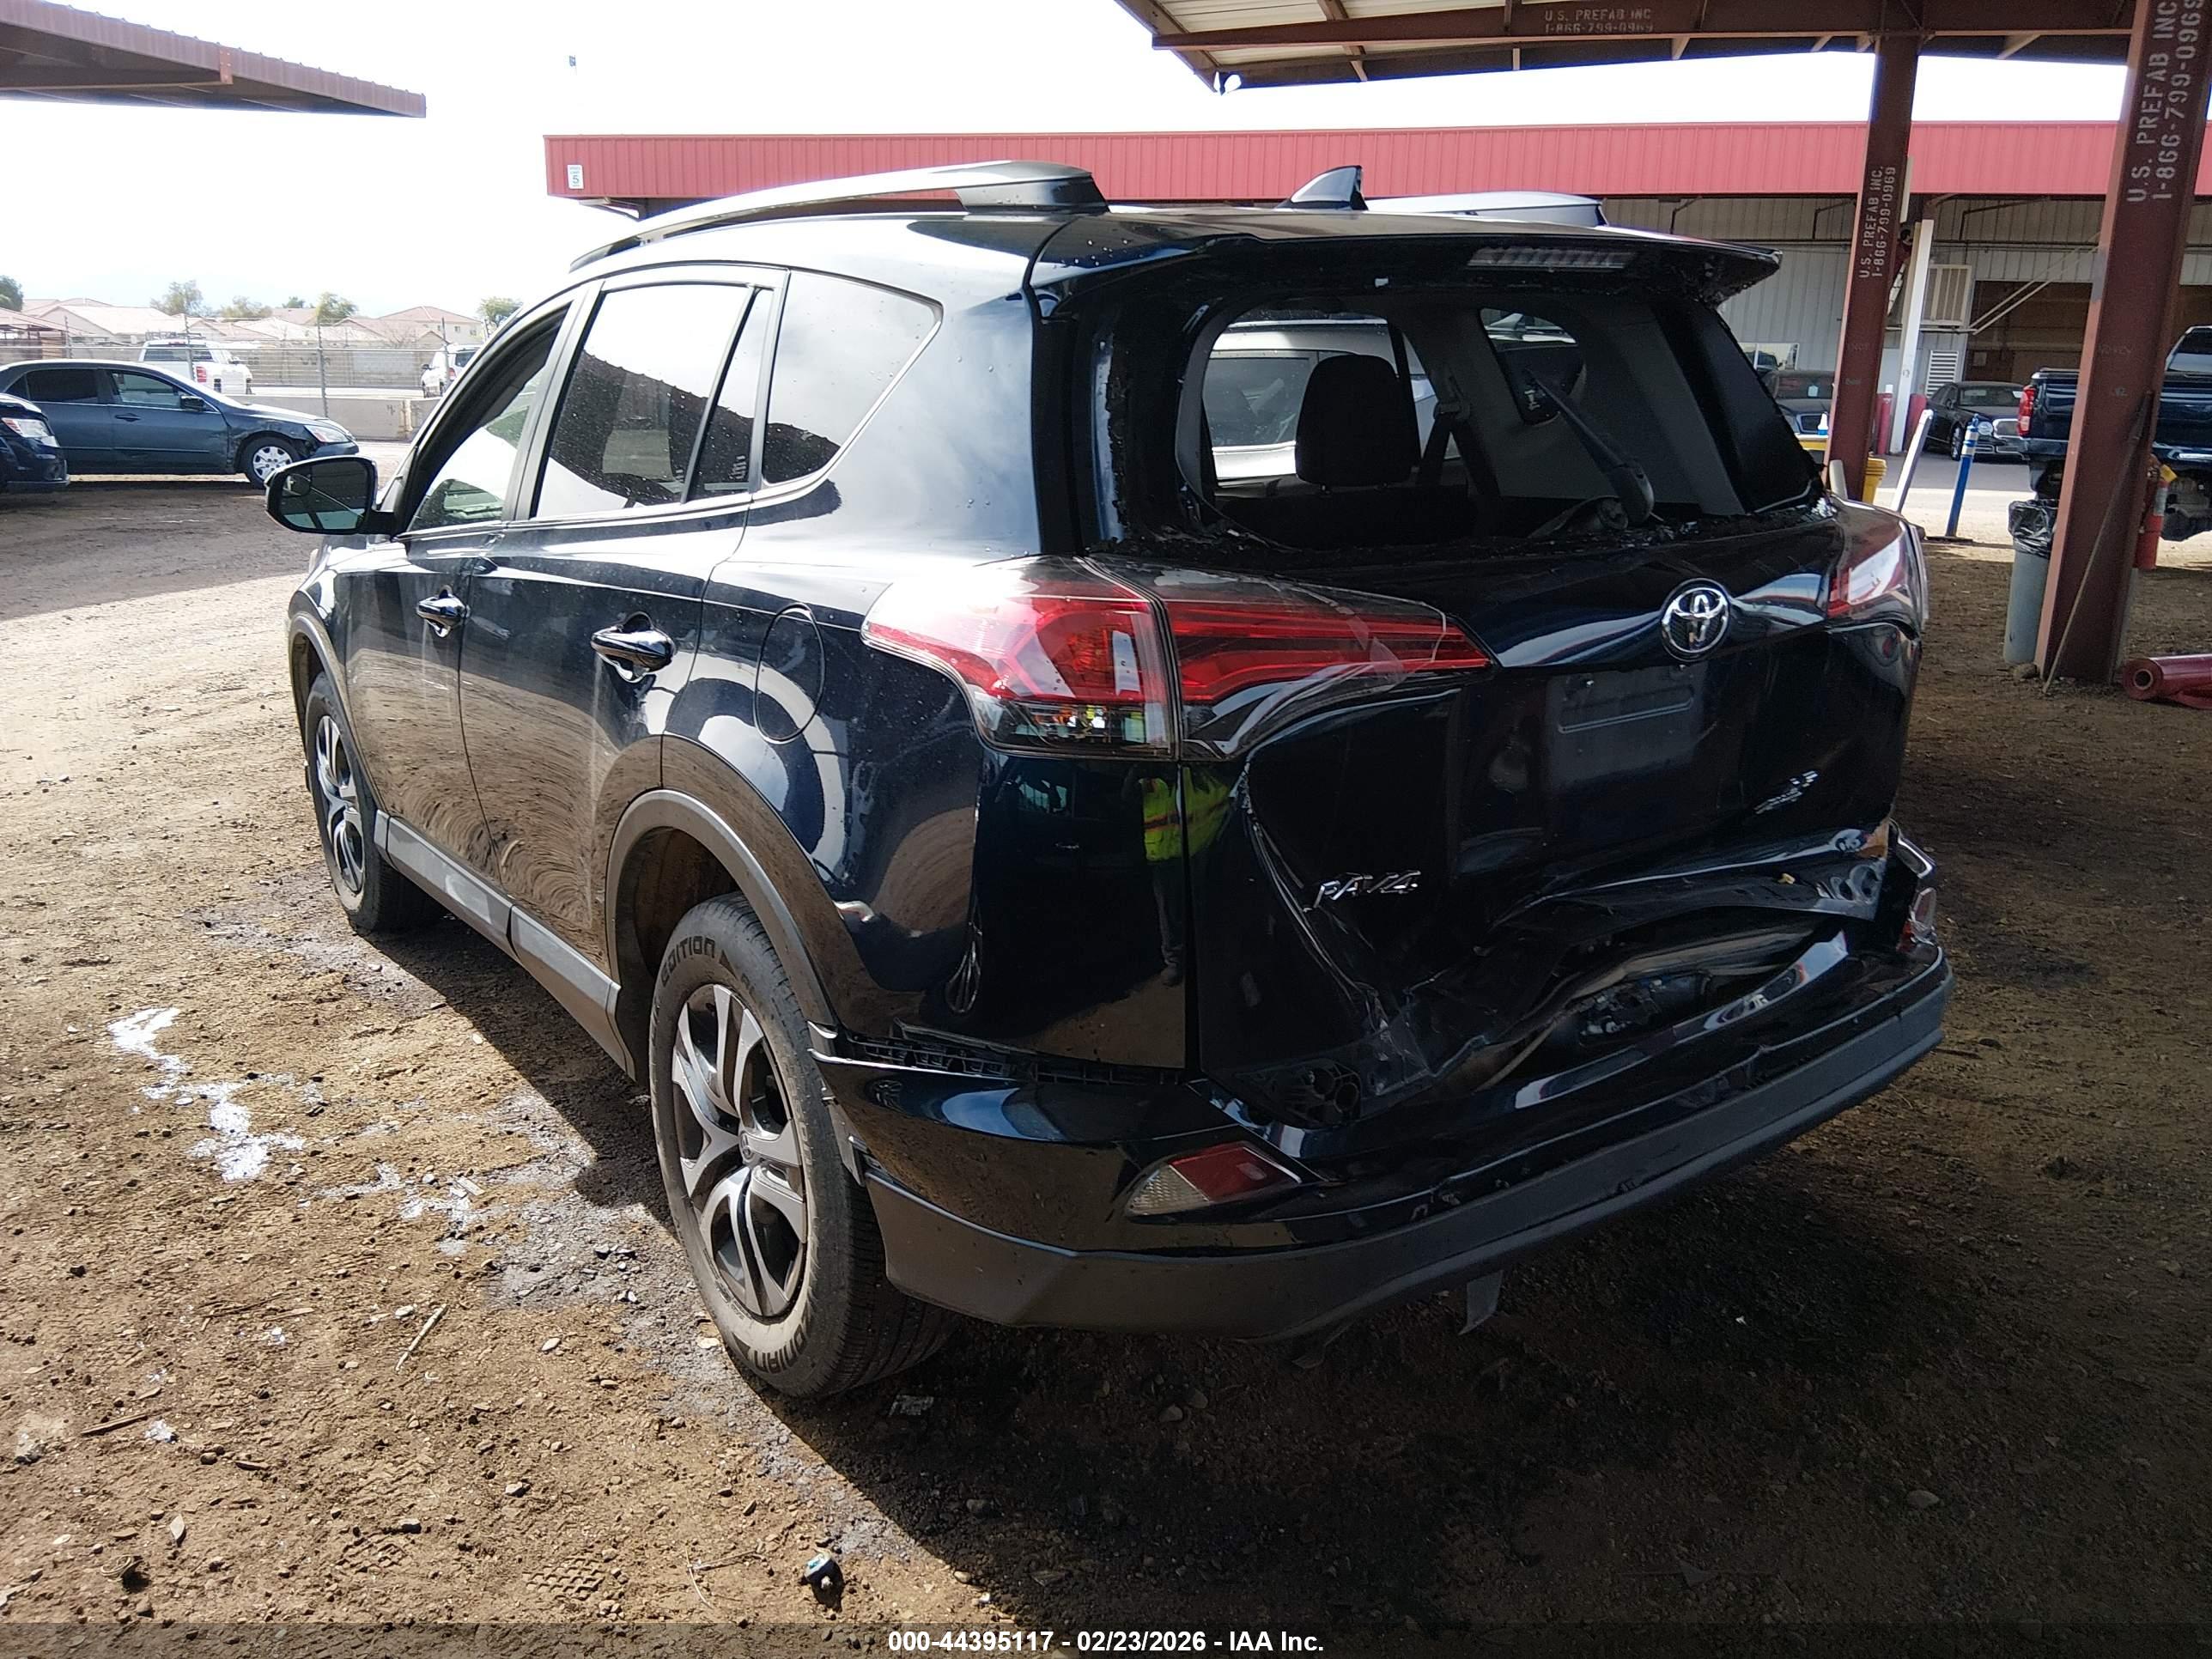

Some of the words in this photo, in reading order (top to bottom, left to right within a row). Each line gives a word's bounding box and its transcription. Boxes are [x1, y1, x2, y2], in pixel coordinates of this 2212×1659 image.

[1576, 9, 1625, 21] PREFAB
[2136, 52, 2170, 144] PREFAB
[1869, 166, 1884, 191] INC.
[2126, 158, 2153, 202] U.S.
[1863, 197, 1879, 246] PREFAB
[1872, 167, 1896, 276] 1-866-799-0969
[1858, 253, 1873, 278] U.S.
